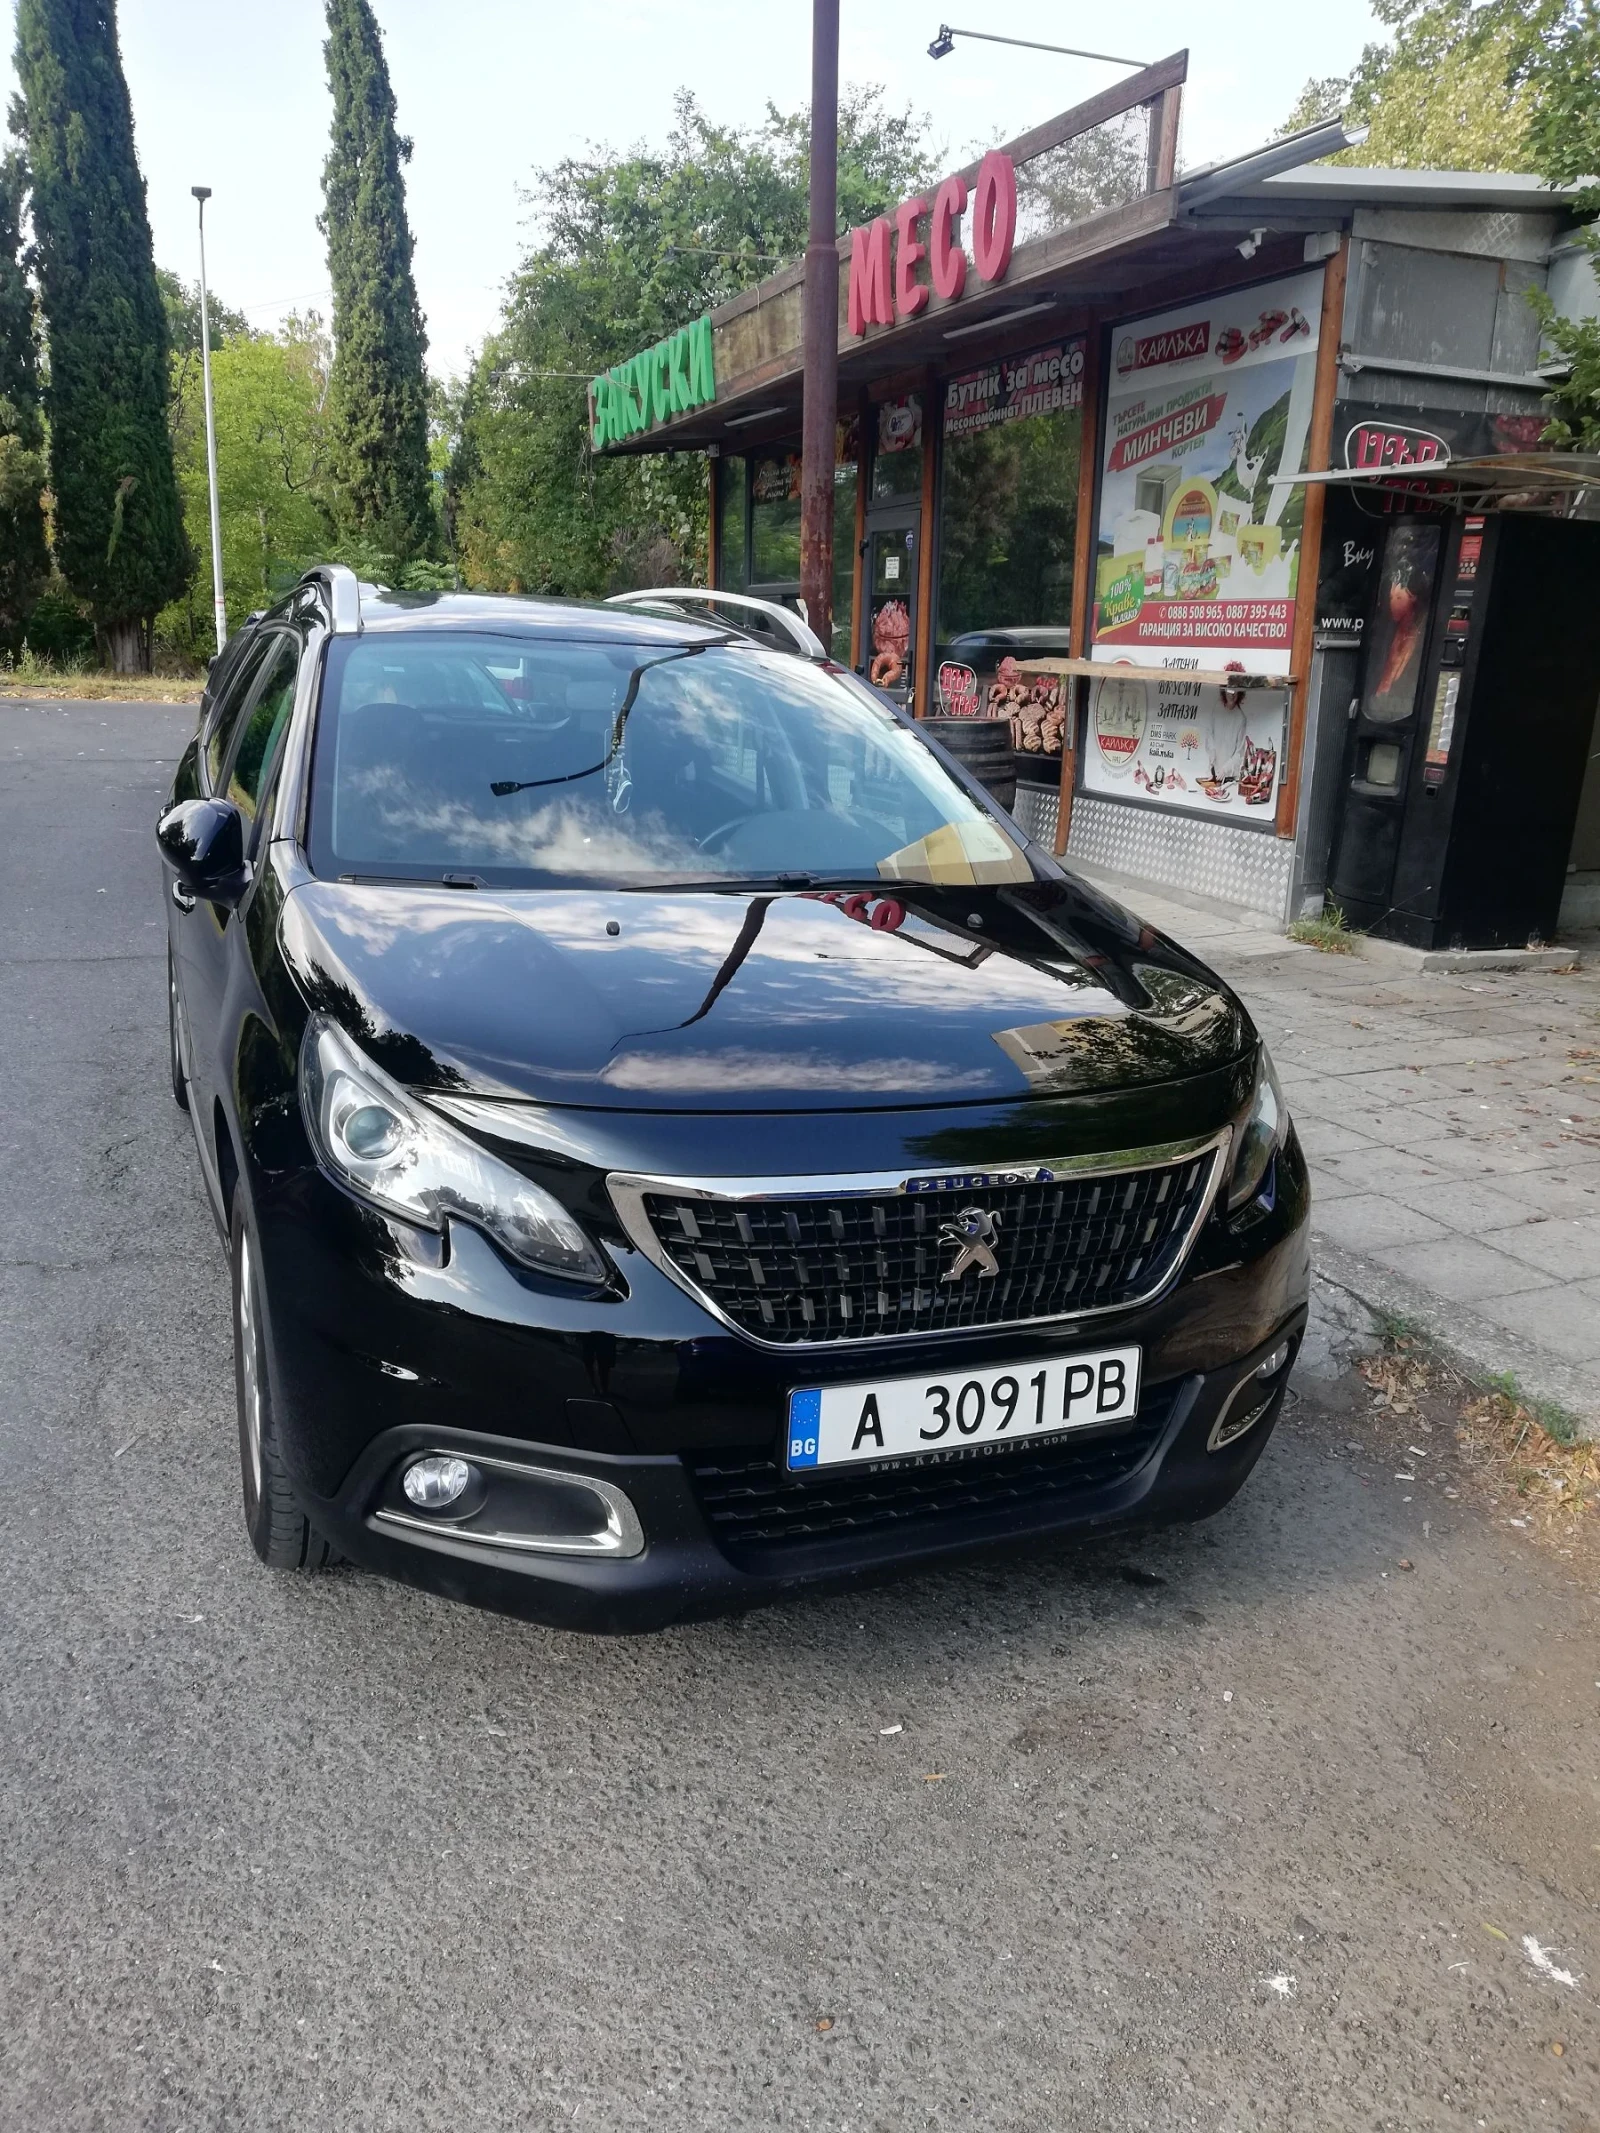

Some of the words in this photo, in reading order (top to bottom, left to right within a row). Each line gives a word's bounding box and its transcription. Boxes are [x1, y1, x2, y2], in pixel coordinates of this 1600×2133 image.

[848, 150, 1017, 337] МЕСО
[1138, 328, 1206, 364] КАЙЛЪКА
[592, 315, 715, 449] ЗАКУСКИ
[947, 374, 1001, 410] Бутик
[1006, 365, 1028, 392] за
[1033, 350, 1084, 385] месо
[945, 404, 1019, 433] Месокомбинат
[1021, 381, 1083, 415] ПЛЕВЕН
[1113, 400, 1145, 426] ТЪРСЕТЕ
[1117, 405, 1164, 437] НАТУРАЛНИ
[1166, 381, 1213, 413] ПРОДУКТИ
[1123, 403, 1208, 464] МИНЧЕВИ
[1171, 435, 1206, 460] КОРТЕН
[1110, 577, 1132, 598] 100%
[1167, 606, 1187, 619] 0888
[1189, 606, 1204, 619] 508
[1206, 605, 1224, 621] 965,
[1226, 605, 1248, 619] 0887
[1250, 605, 1267, 619] 395
[1268, 604, 1287, 619] 443
[1139, 623, 1180, 639] ГАРАНЦИЯ
[1182, 623, 1193, 637] ЗА
[1195, 623, 1232, 637] ВИСОКО
[1233, 623, 1287, 638] КАЧЕСТВО!
[1157, 702, 1198, 720] ЗАПАЗИ
[1150, 730, 1162, 739] DMS
[1162, 731, 1177, 740] PARK
[918, 1171, 1036, 1191] PEUGEOT
[851, 1393, 885, 1450] A
[791, 1438, 816, 1458] BG
